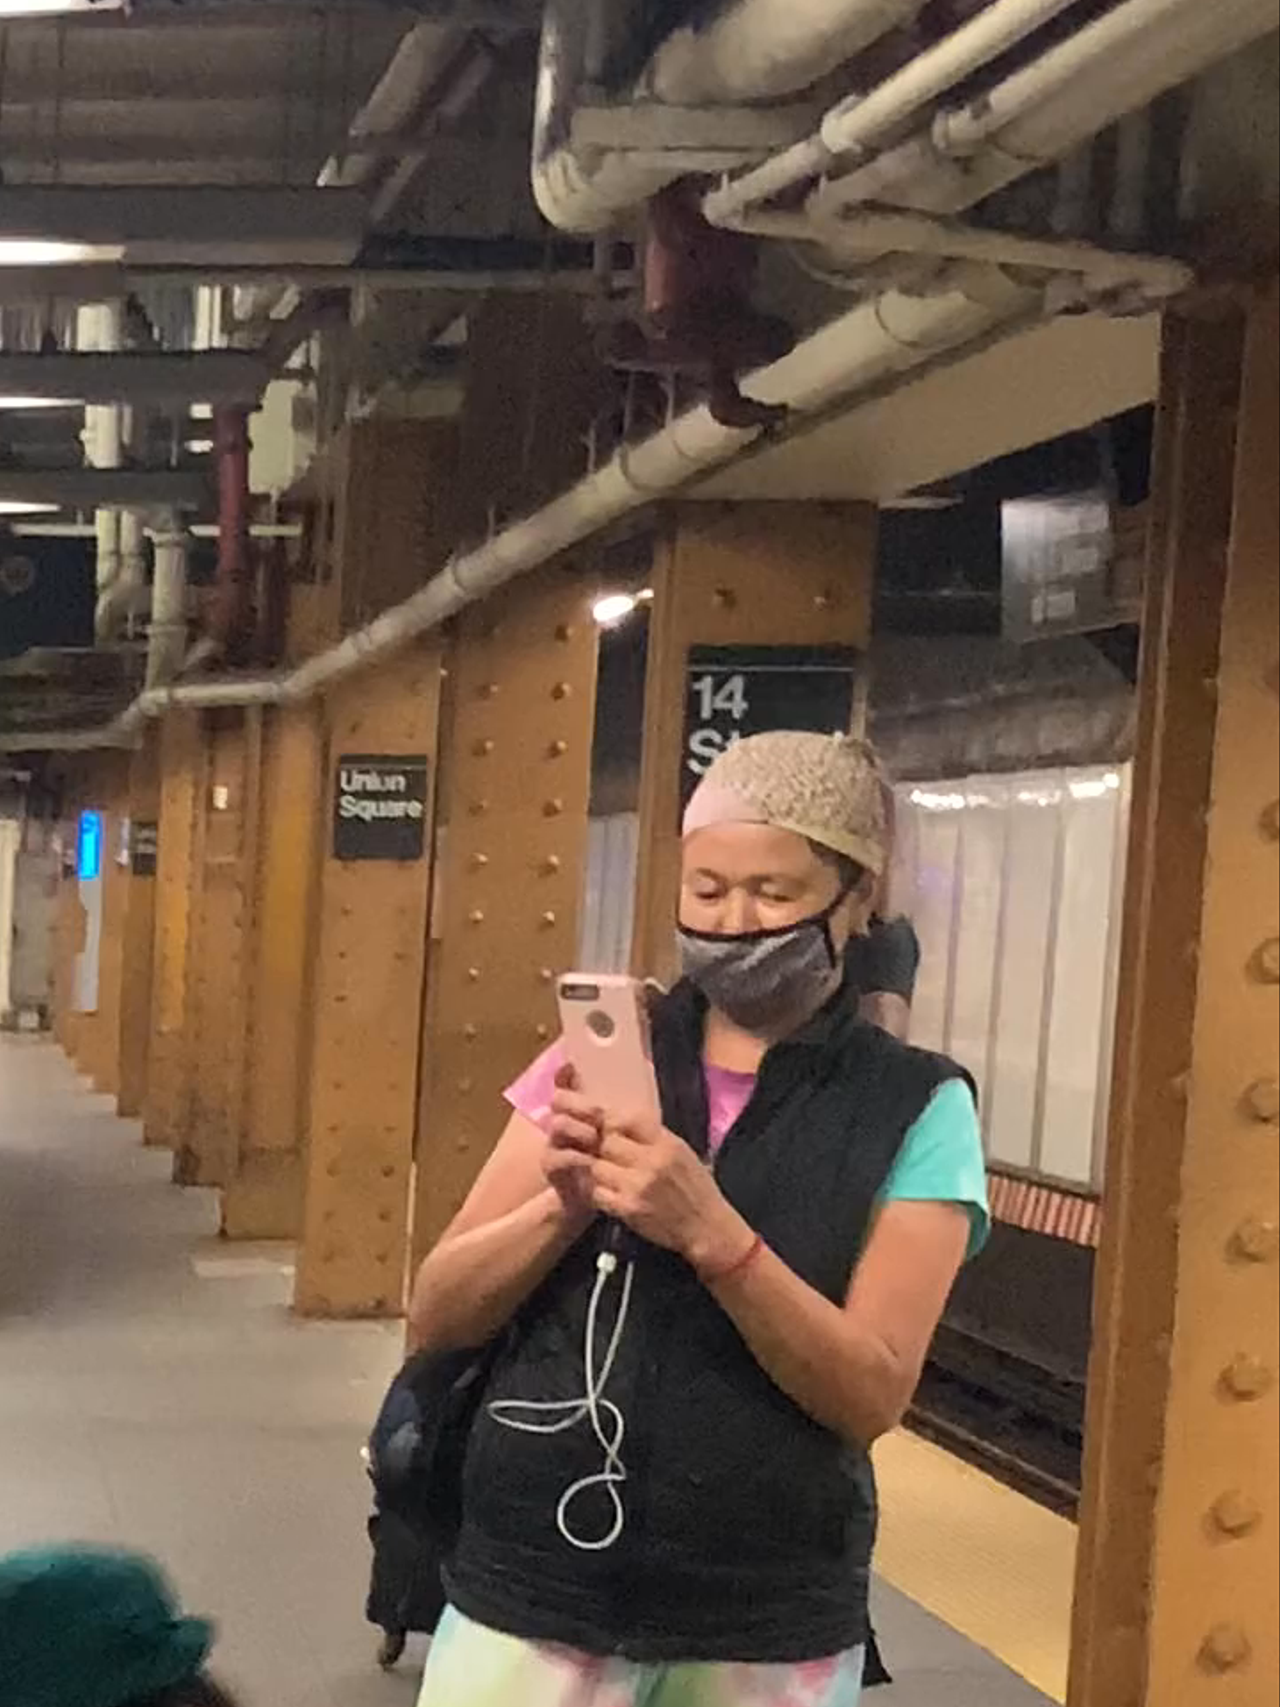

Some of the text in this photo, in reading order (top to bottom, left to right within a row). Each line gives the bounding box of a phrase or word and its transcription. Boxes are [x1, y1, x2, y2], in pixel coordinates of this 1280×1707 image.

[692, 675, 749, 720] 14
[340, 769, 406, 792] Union
[339, 794, 423, 821] Square
